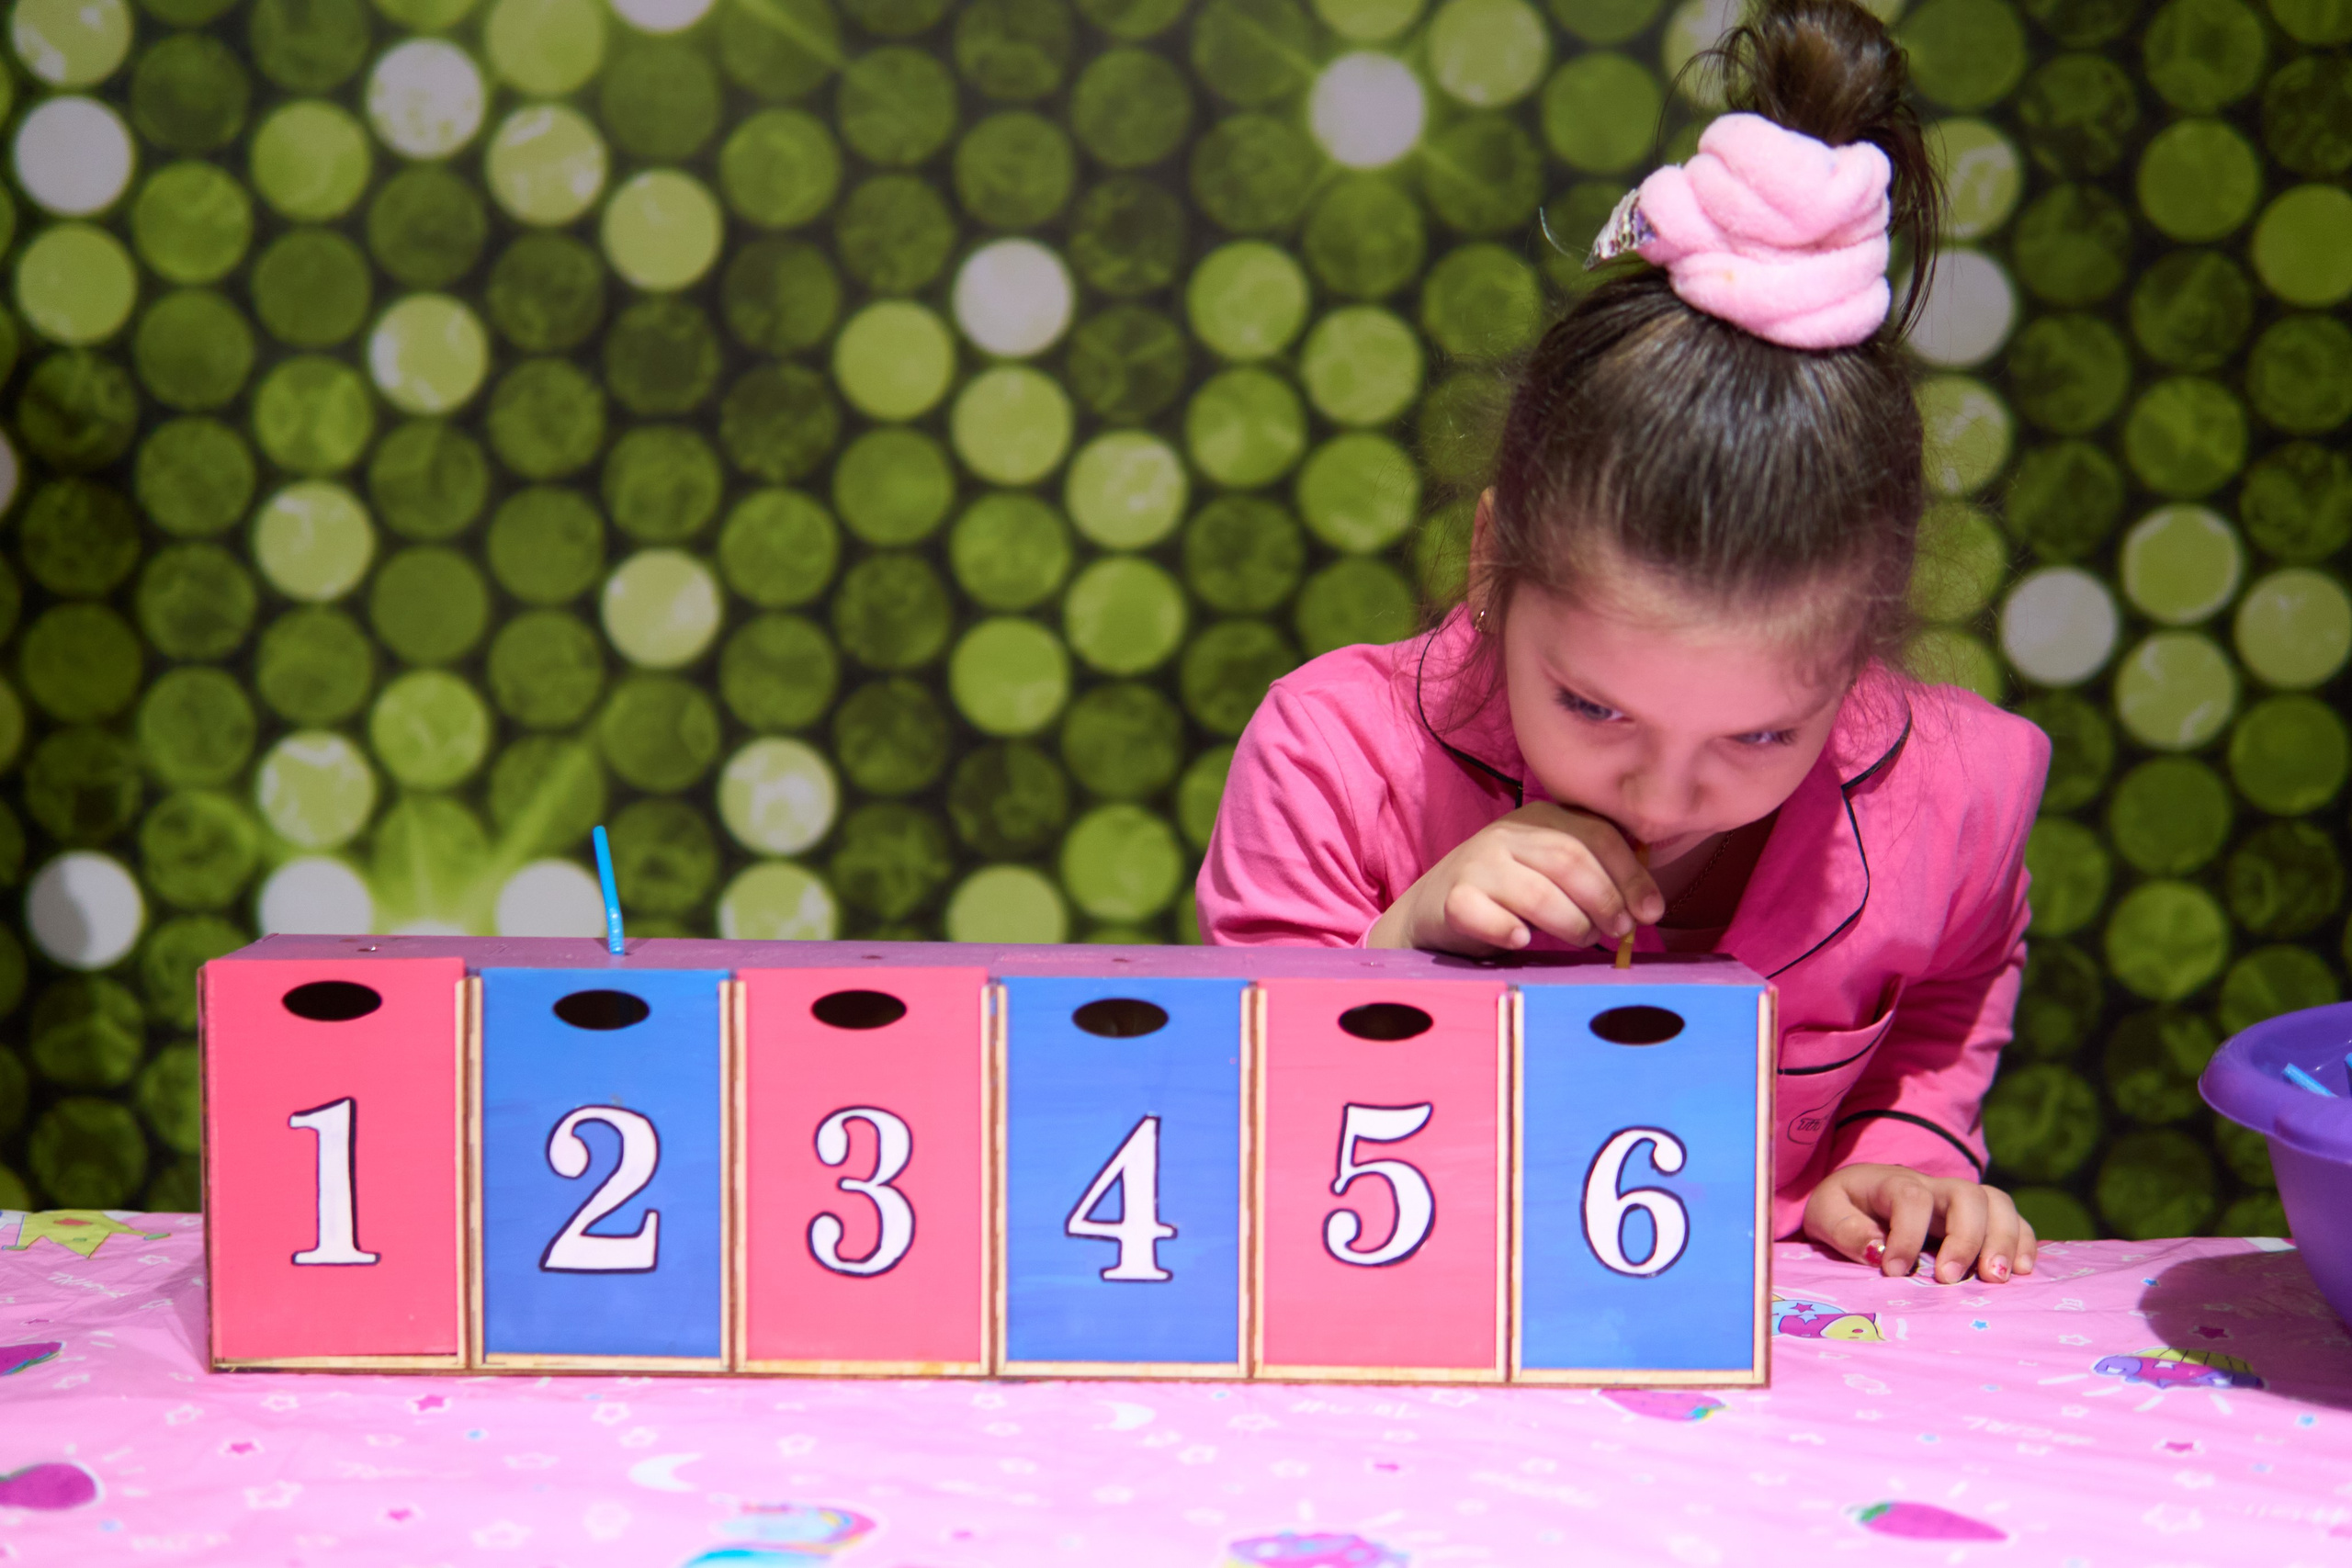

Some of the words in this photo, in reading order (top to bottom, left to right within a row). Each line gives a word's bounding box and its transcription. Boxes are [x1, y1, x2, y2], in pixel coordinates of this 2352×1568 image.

[288, 1097, 382, 1268] 1
[539, 1106, 662, 1274] 2
[807, 1105, 915, 1278] 3
[1064, 1113, 1177, 1282] 4
[1323, 1103, 1438, 1268] 5
[1582, 1127, 1690, 1278] 6
